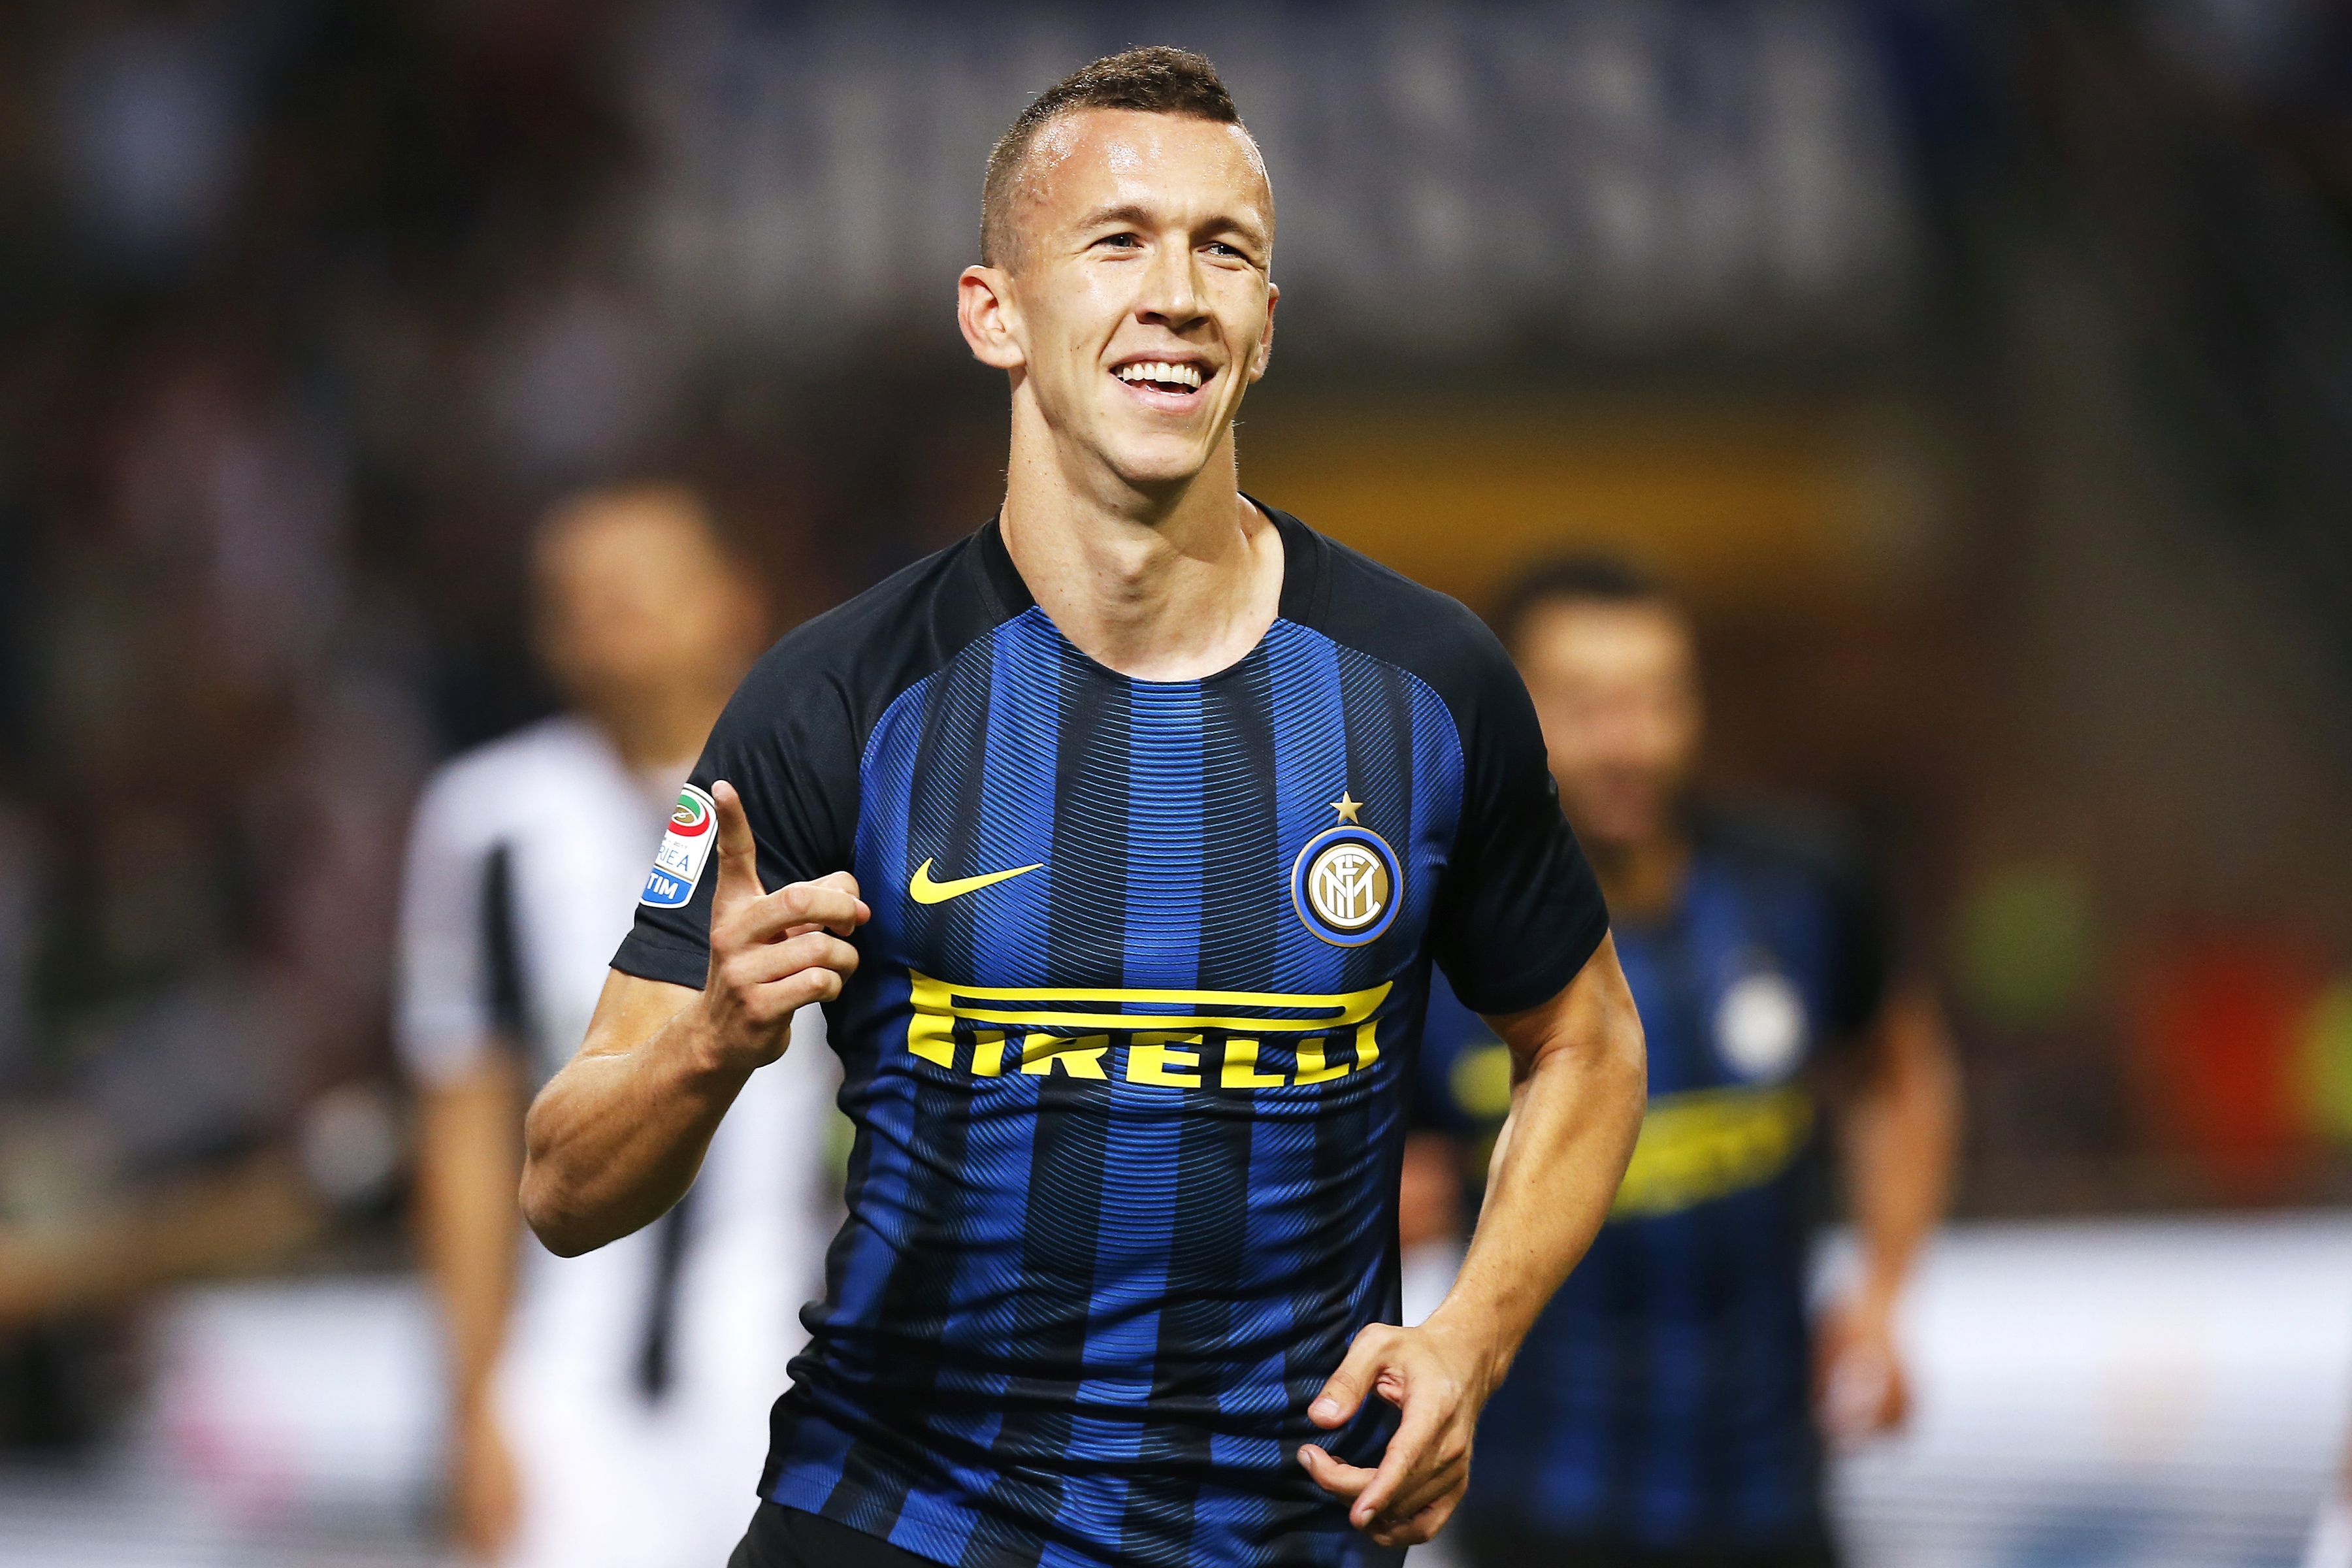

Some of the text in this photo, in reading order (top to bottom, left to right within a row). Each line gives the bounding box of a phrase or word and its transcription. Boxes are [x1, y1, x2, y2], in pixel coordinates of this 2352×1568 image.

[659, 845, 689, 872] RIE A
[647, 872, 679, 900] TIM
[907, 969, 1394, 1088] PIRELLI
